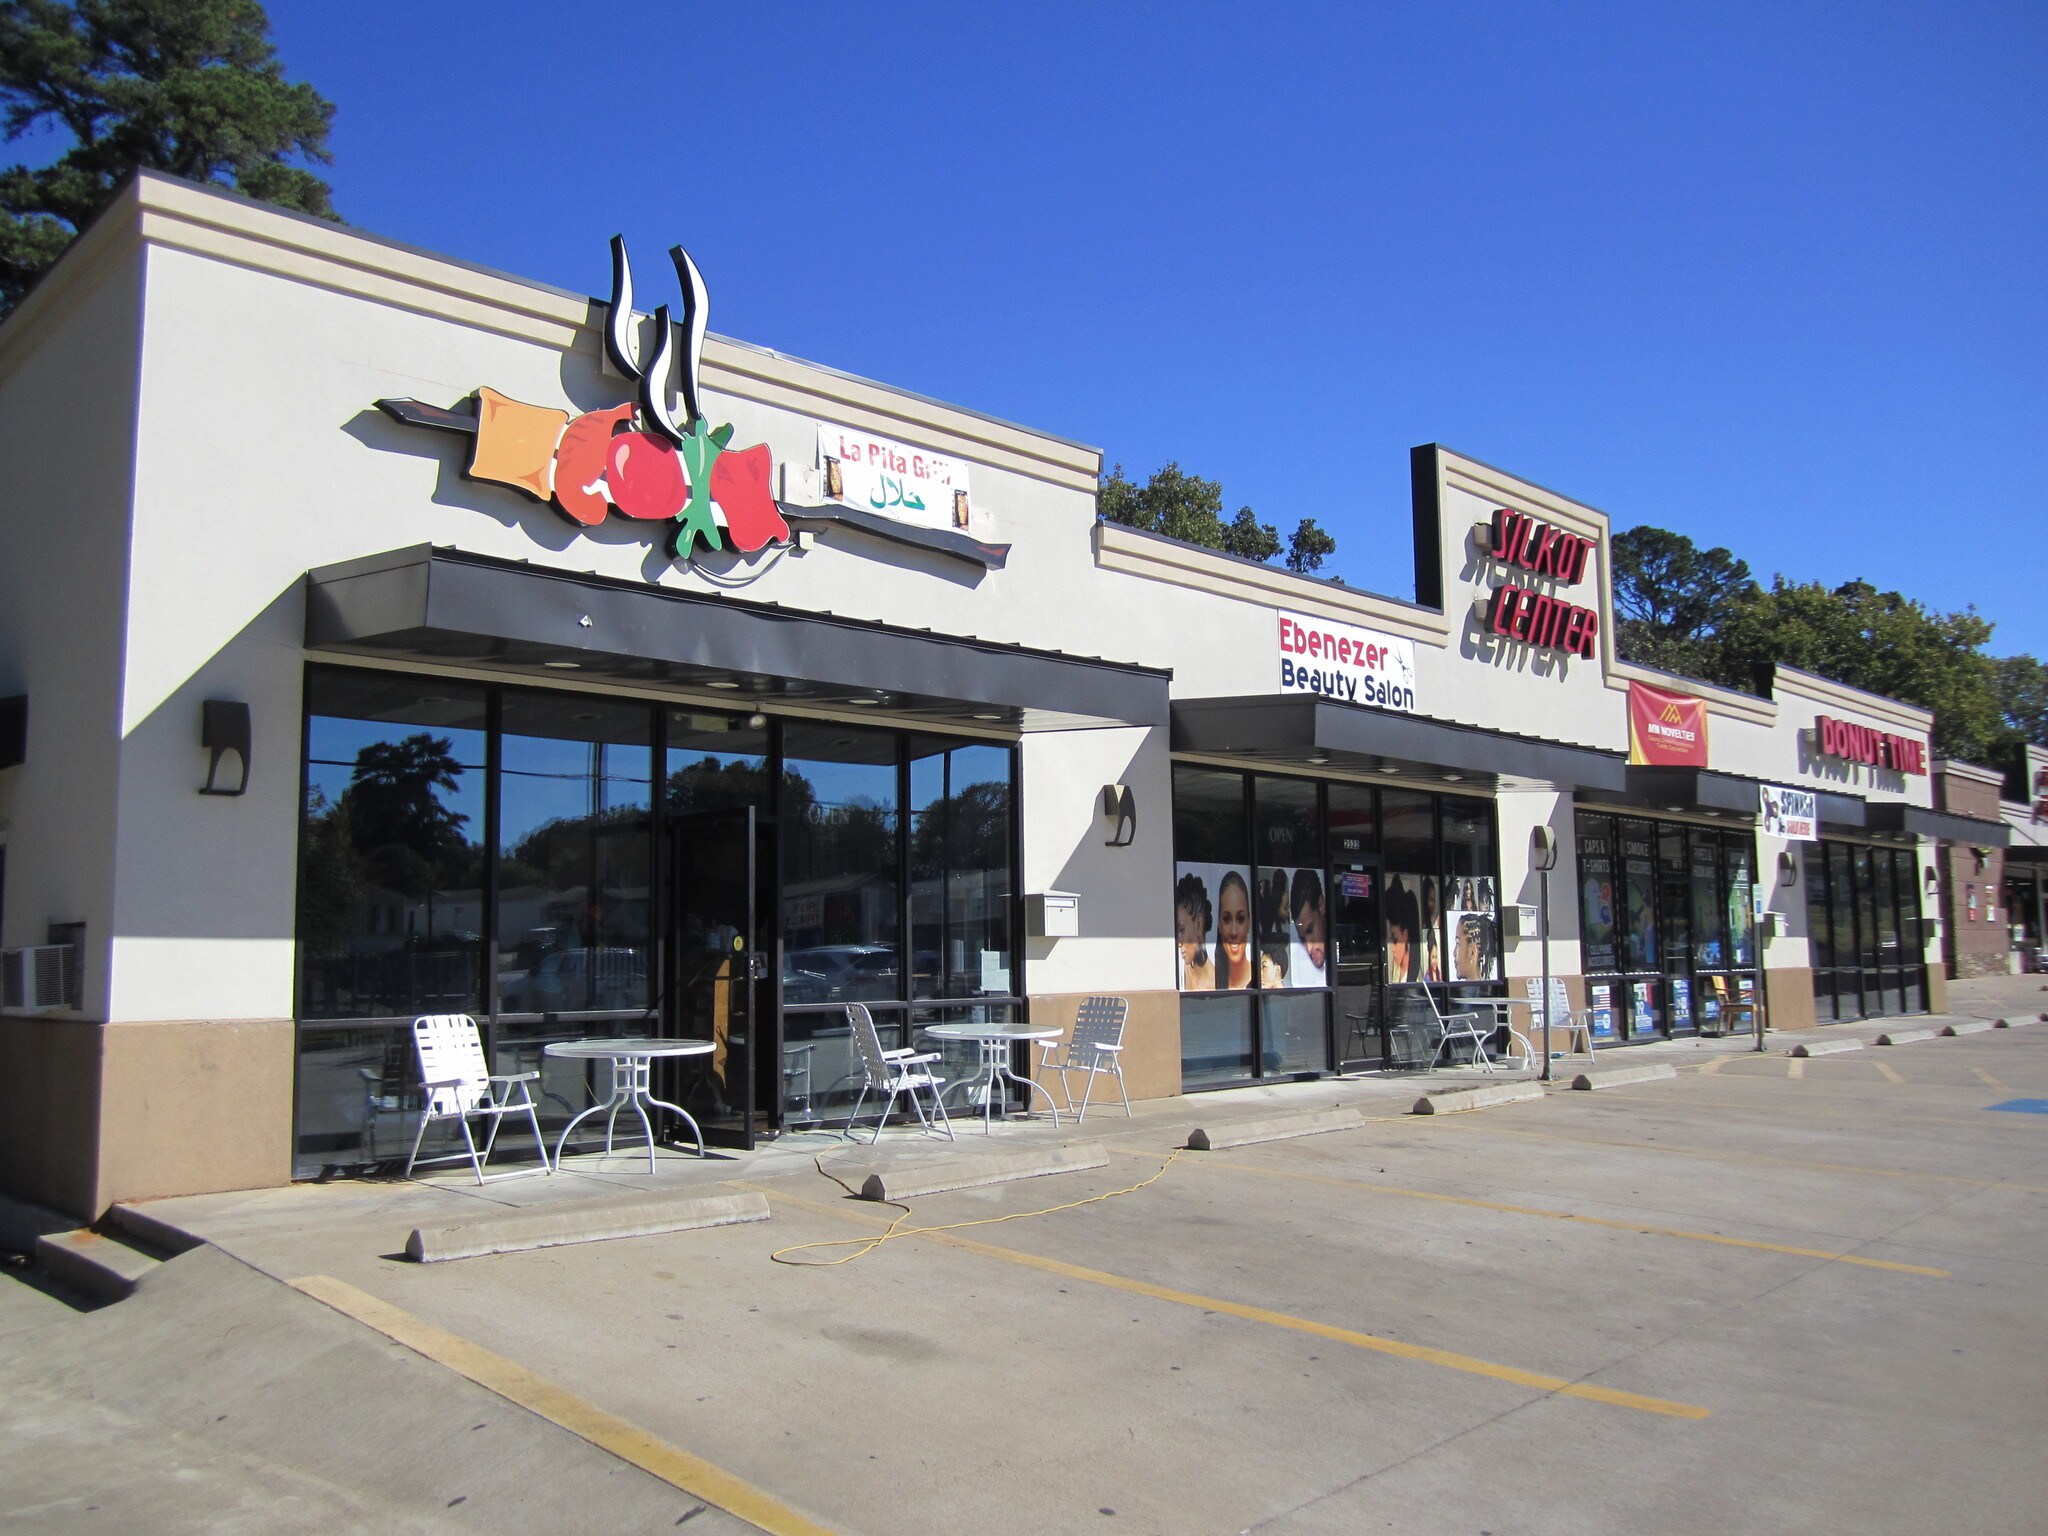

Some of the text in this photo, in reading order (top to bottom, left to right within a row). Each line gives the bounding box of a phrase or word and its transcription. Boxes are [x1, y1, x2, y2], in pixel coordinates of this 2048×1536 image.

[839, 435, 861, 462] La
[868, 443, 907, 475] Pita
[1490, 584, 1598, 661] CENTER
[1279, 617, 1389, 671] Ebenezer
[1281, 658, 1414, 710] Beauty Salon
[1819, 715, 1927, 776] DONUT TIME
[808, 803, 850, 825] OPEN
[1268, 826, 1294, 843] OPEN
[1584, 839, 1599, 854] CAPS
[1626, 841, 1649, 856] SMOKE
[1582, 859, 1610, 873] T-SHIRTS
